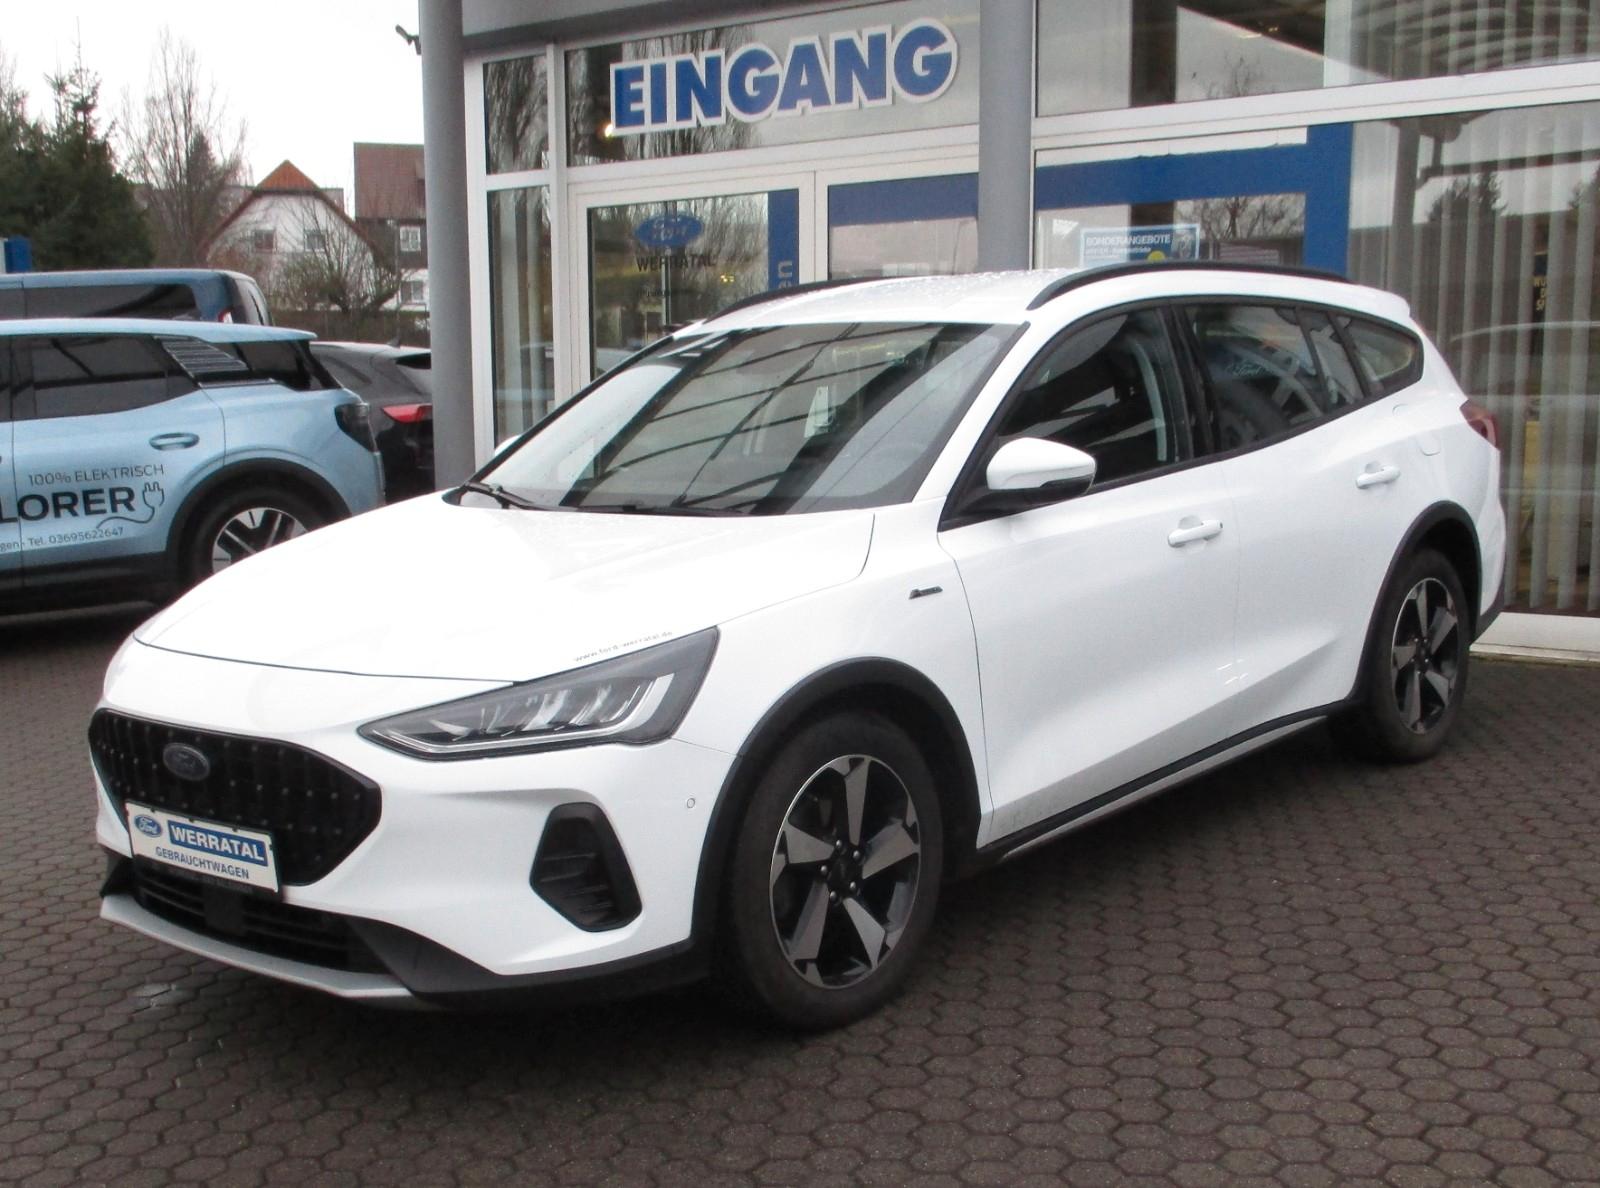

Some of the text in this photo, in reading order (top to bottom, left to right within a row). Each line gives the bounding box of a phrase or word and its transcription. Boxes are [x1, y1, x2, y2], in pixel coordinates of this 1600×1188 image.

[611, 19, 956, 133] EINGANG
[28, 464, 164, 486] 100% ELEKTRISCH
[137, 815, 160, 836] Ford
[171, 825, 265, 862] WERRATAL
[155, 846, 249, 879] GEBRAUCHTWAGEN
